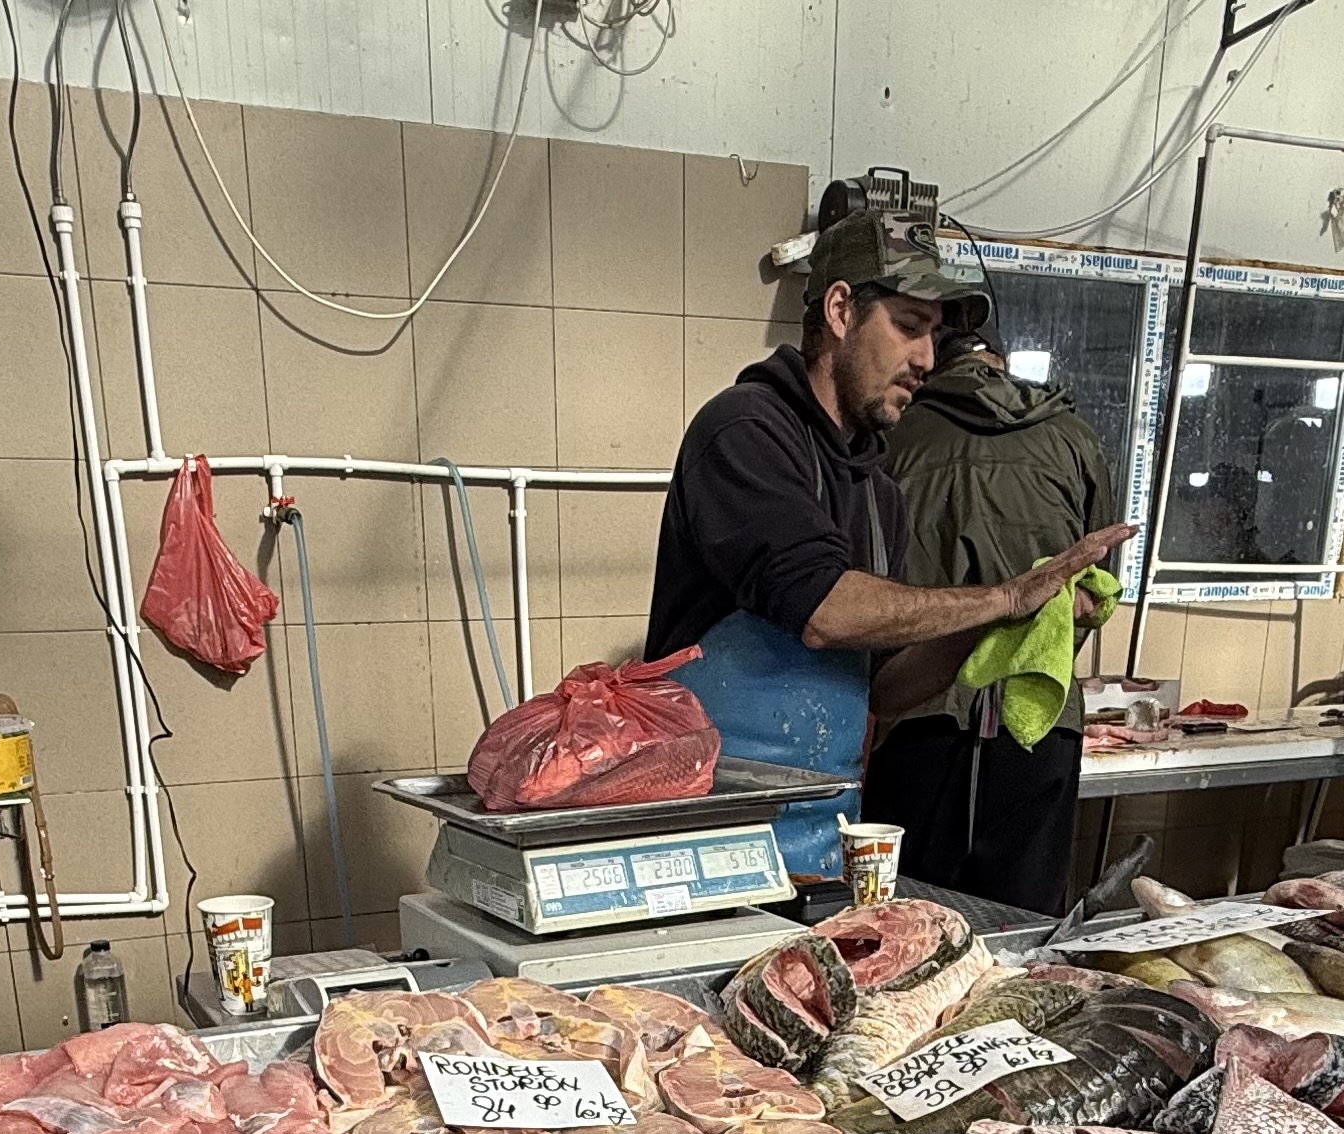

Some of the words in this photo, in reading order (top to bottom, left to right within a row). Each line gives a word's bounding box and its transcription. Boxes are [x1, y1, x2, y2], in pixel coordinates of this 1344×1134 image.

[1079, 253, 1139, 270] ramplast
[1197, 265, 1249, 283] ramplas
[1199, 584, 1250, 597] ramplast
[429, 1055, 557, 1078] RONDELE
[866, 1033, 975, 1088] RONDELE
